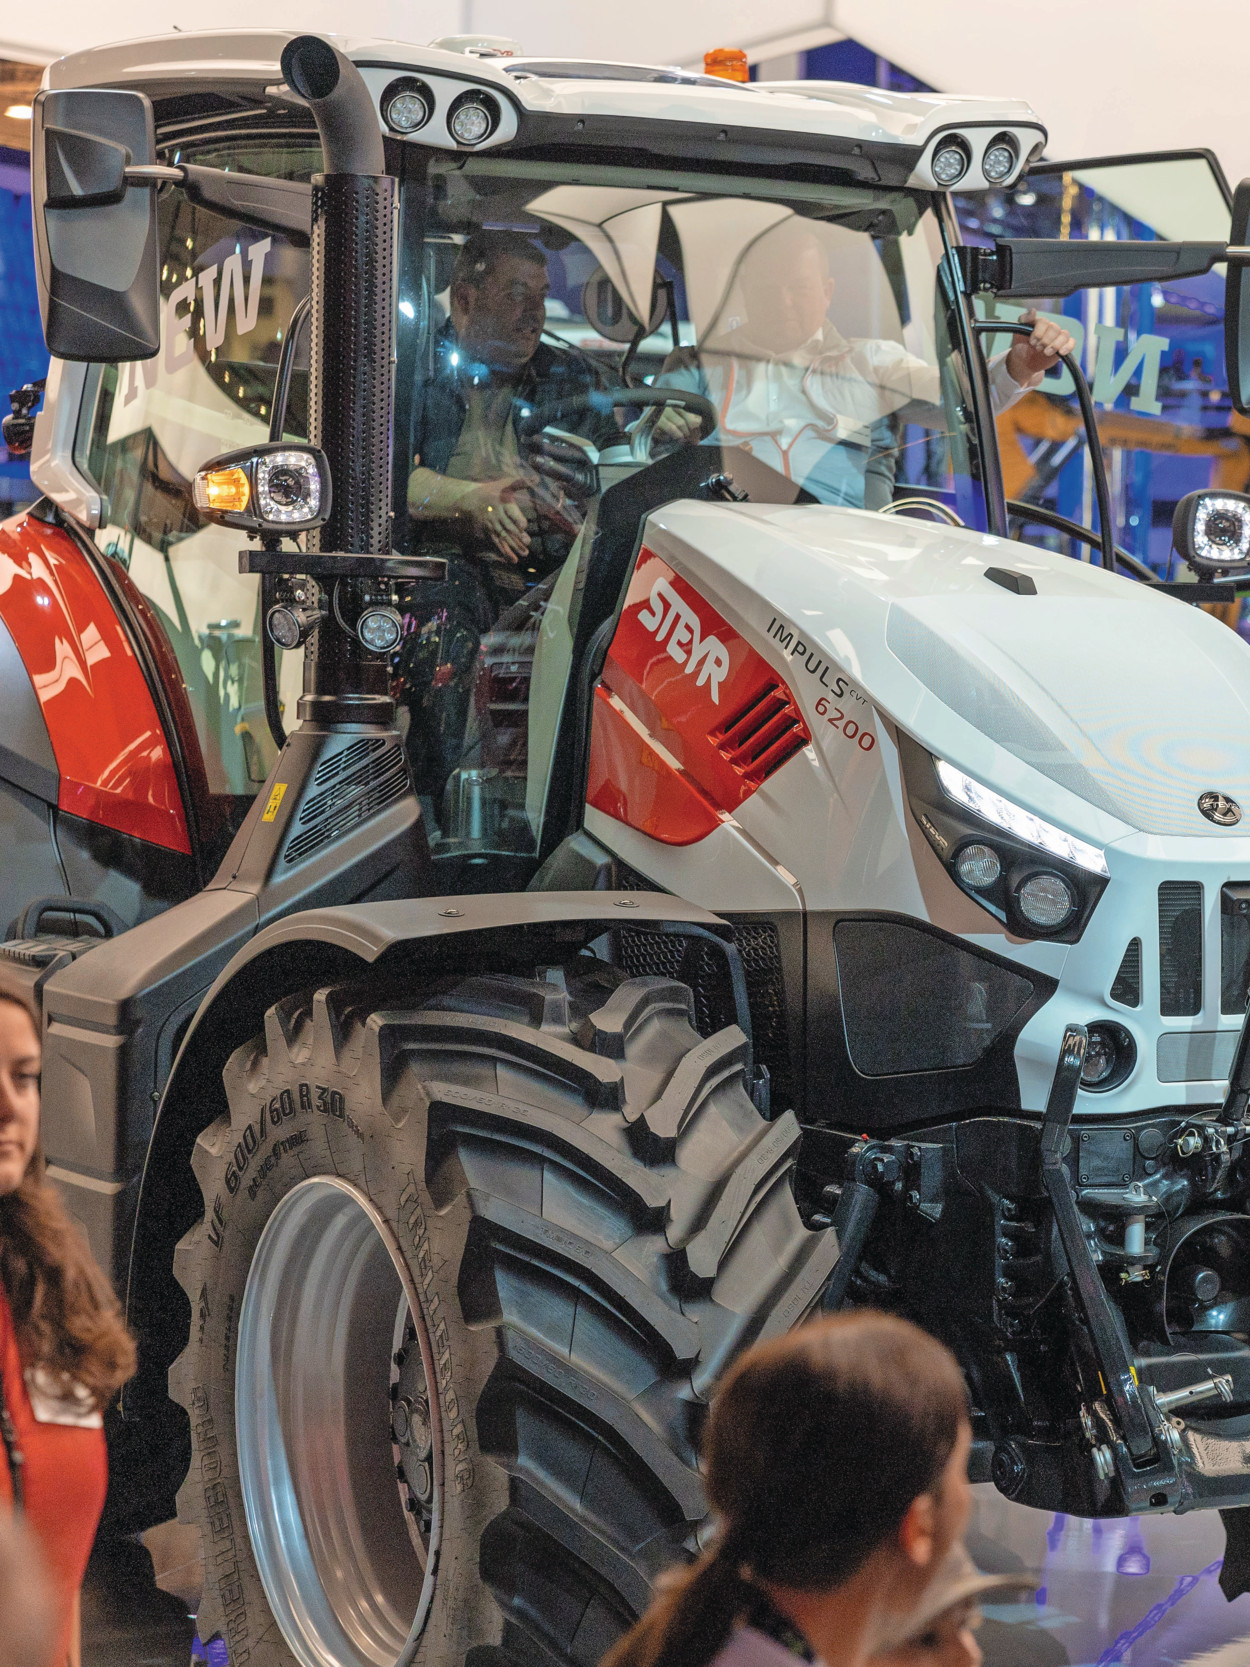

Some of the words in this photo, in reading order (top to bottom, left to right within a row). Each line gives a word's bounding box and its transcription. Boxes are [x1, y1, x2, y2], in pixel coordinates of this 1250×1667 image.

[637, 576, 730, 706] STEYR
[765, 616, 850, 699] IMPULS
[849, 688, 868, 706] CVT
[814, 696, 876, 752] 6200
[207, 1191, 226, 1252] VF
[224, 1087, 297, 1198] 600/60
[298, 1081, 313, 1113] R
[315, 1084, 346, 1120] 30
